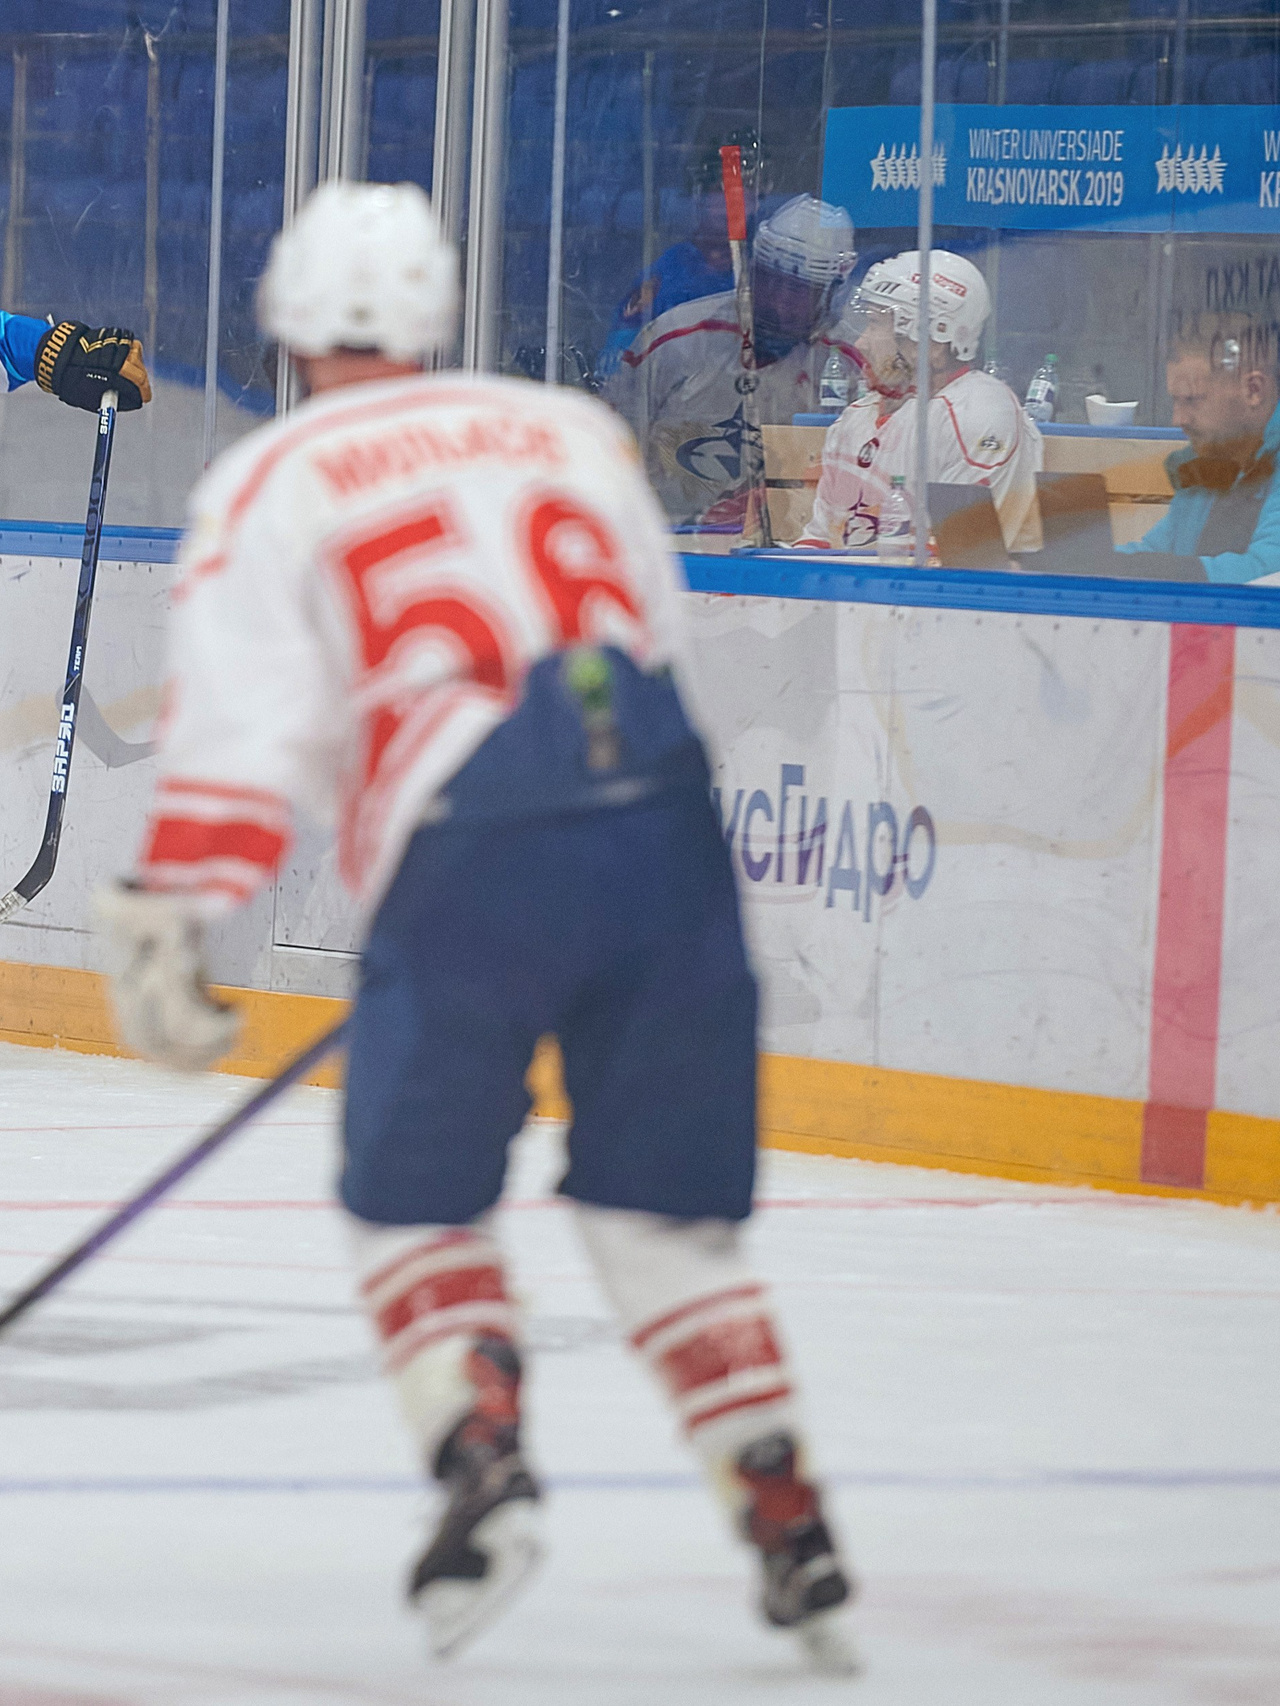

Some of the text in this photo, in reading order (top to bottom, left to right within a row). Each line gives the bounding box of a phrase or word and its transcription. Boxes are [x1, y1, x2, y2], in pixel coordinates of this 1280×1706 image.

[969, 128, 1124, 162] WINTER UNIVERSIADE
[967, 167, 1124, 206] KRASNOYARSK 2019
[38, 321, 77, 394] ARRIOR
[73, 645, 83, 672] TEAM
[711, 763, 936, 922] усГидро
